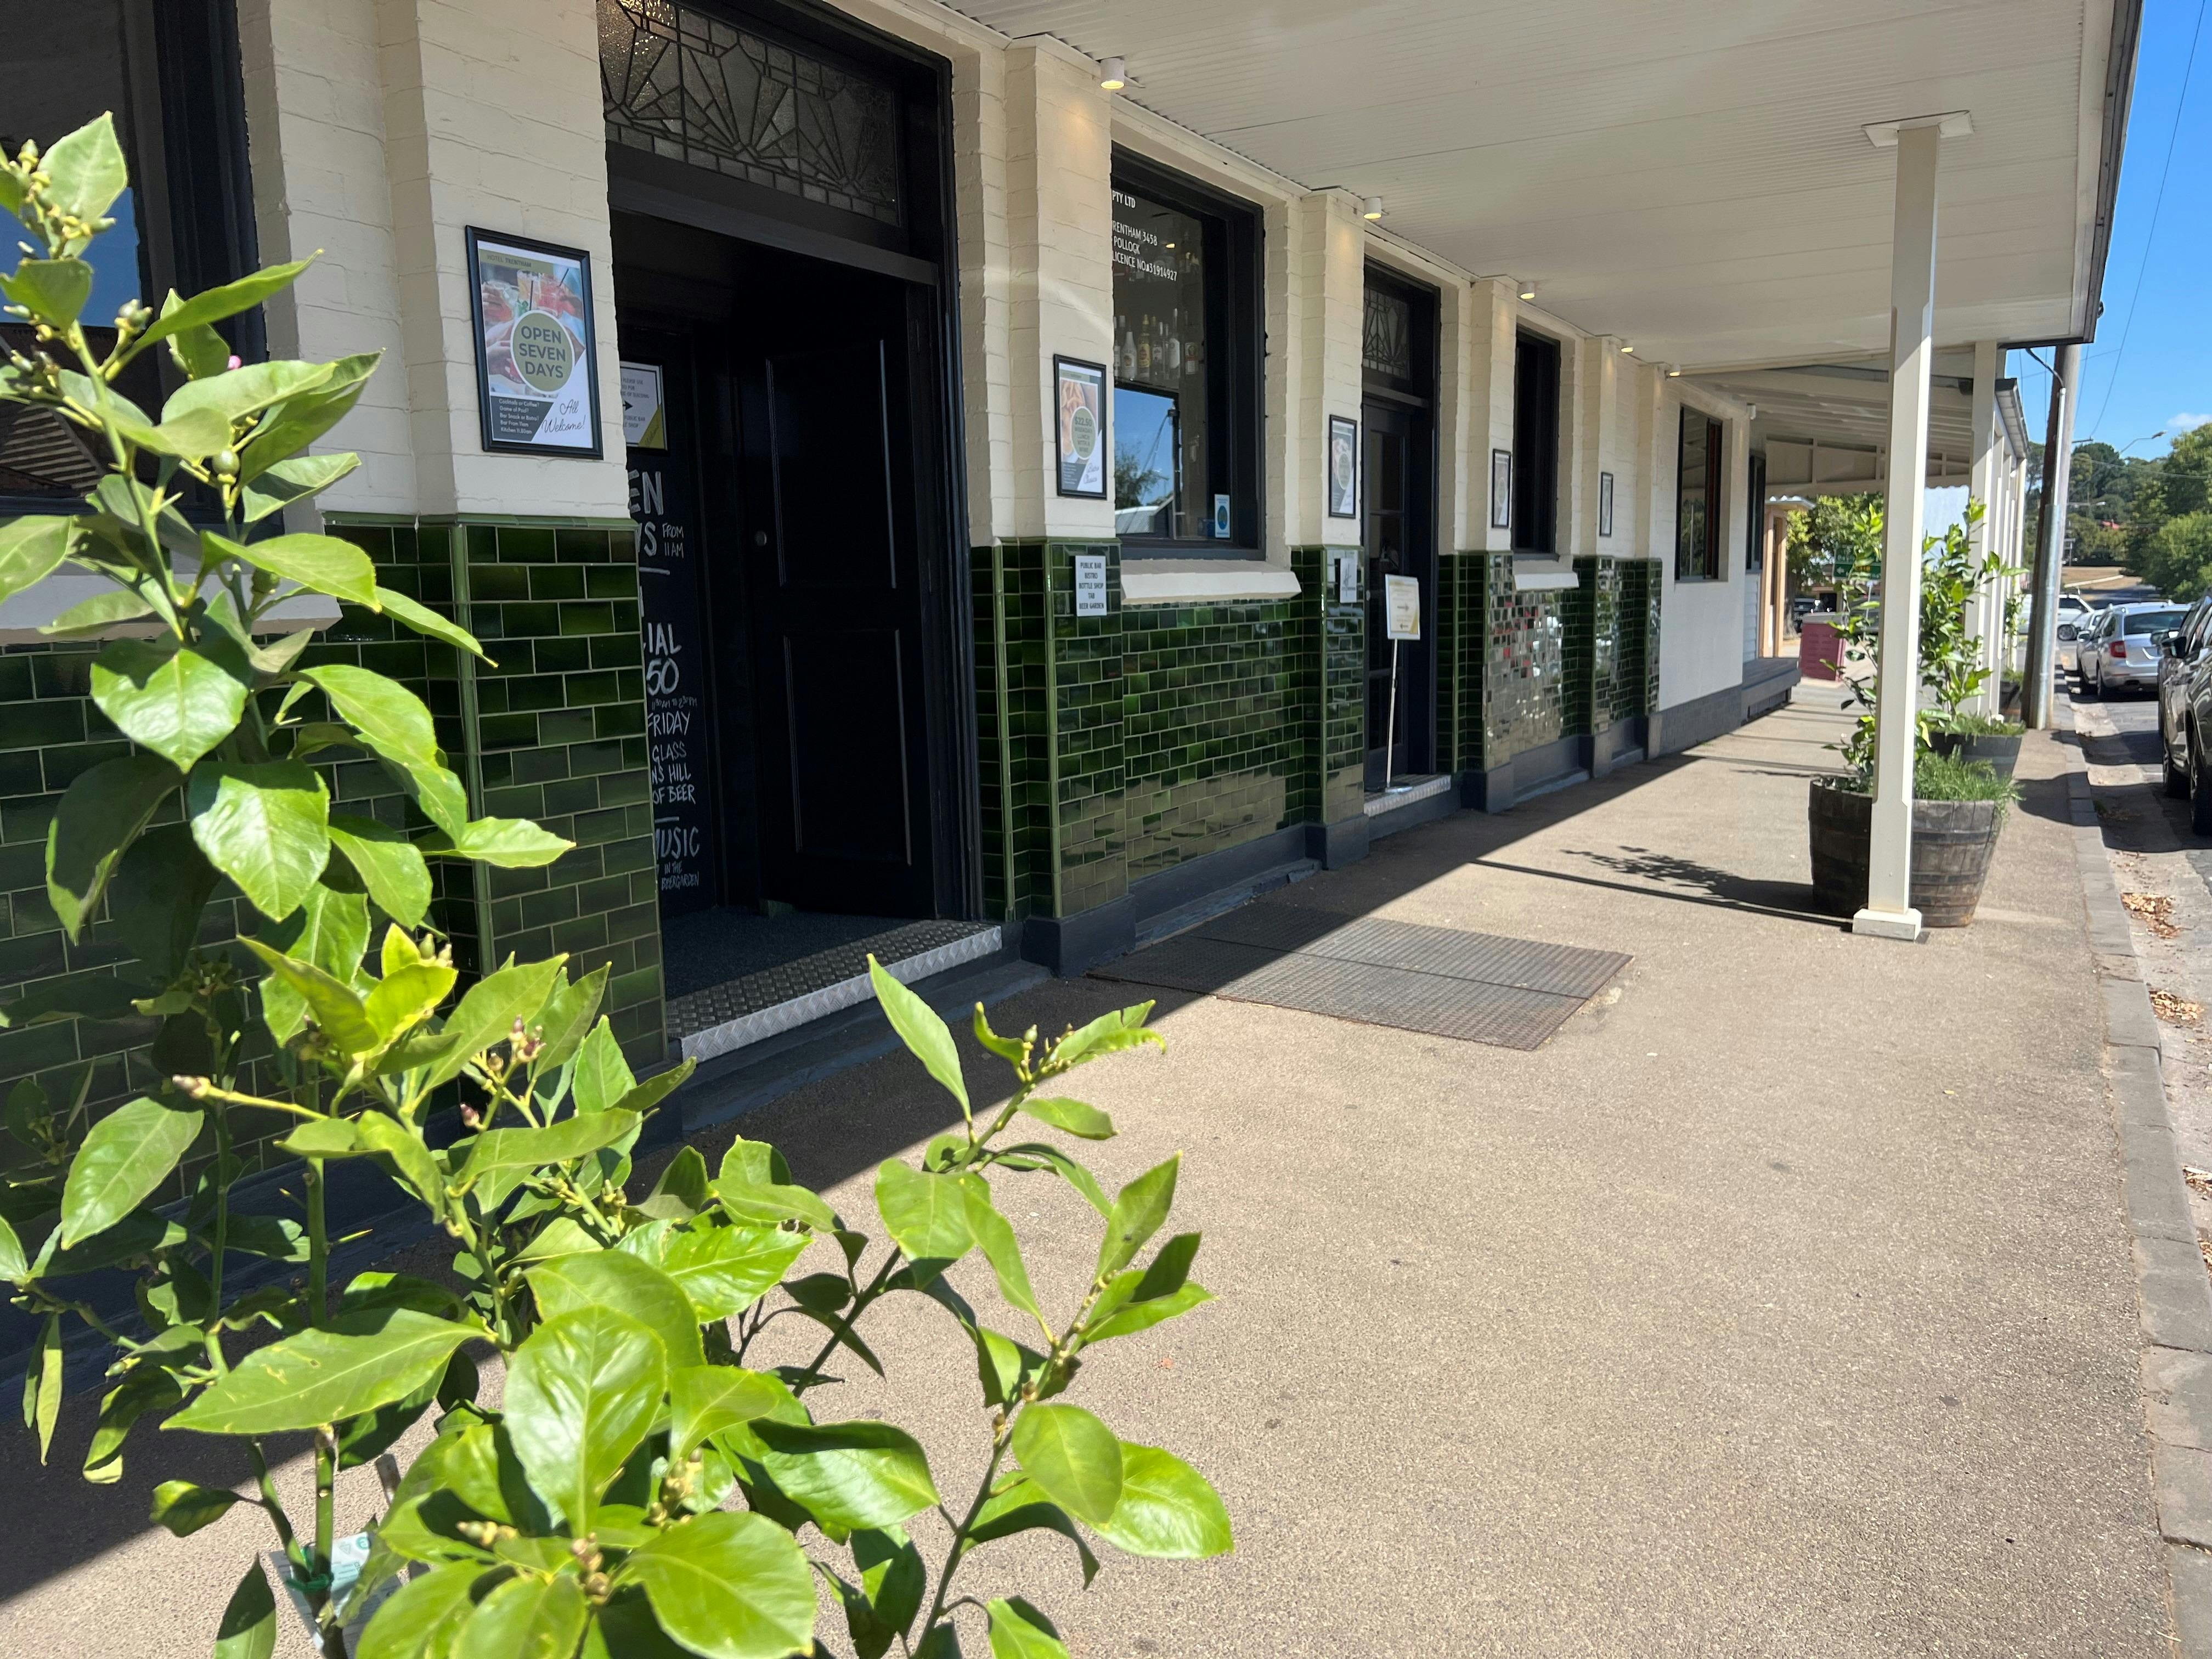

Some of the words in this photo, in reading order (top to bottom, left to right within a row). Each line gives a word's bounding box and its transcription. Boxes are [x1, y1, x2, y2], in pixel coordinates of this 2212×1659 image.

[1112, 190, 1123, 205] PTY
[1125, 195, 1136, 208] LTD
[1114, 236, 1140, 255] POLLOCK
[1143, 231, 1158, 246] 3458
[521, 325, 562, 343] OPEN
[519, 343, 566, 362] SEVEN
[526, 361, 563, 379] DAYS
[560, 399, 579, 415] All
[541, 415, 586, 433] Welcome!
[662, 522, 684, 538] FROM
[644, 622, 681, 656] IAL
[646, 658, 679, 696] 50
[652, 740, 687, 763] GLASS
[668, 763, 691, 784] HILL
[653, 786, 665, 804] OF
[667, 783, 696, 805] BEER
[664, 862, 670, 875] IN
[672, 860, 682, 874] THE
